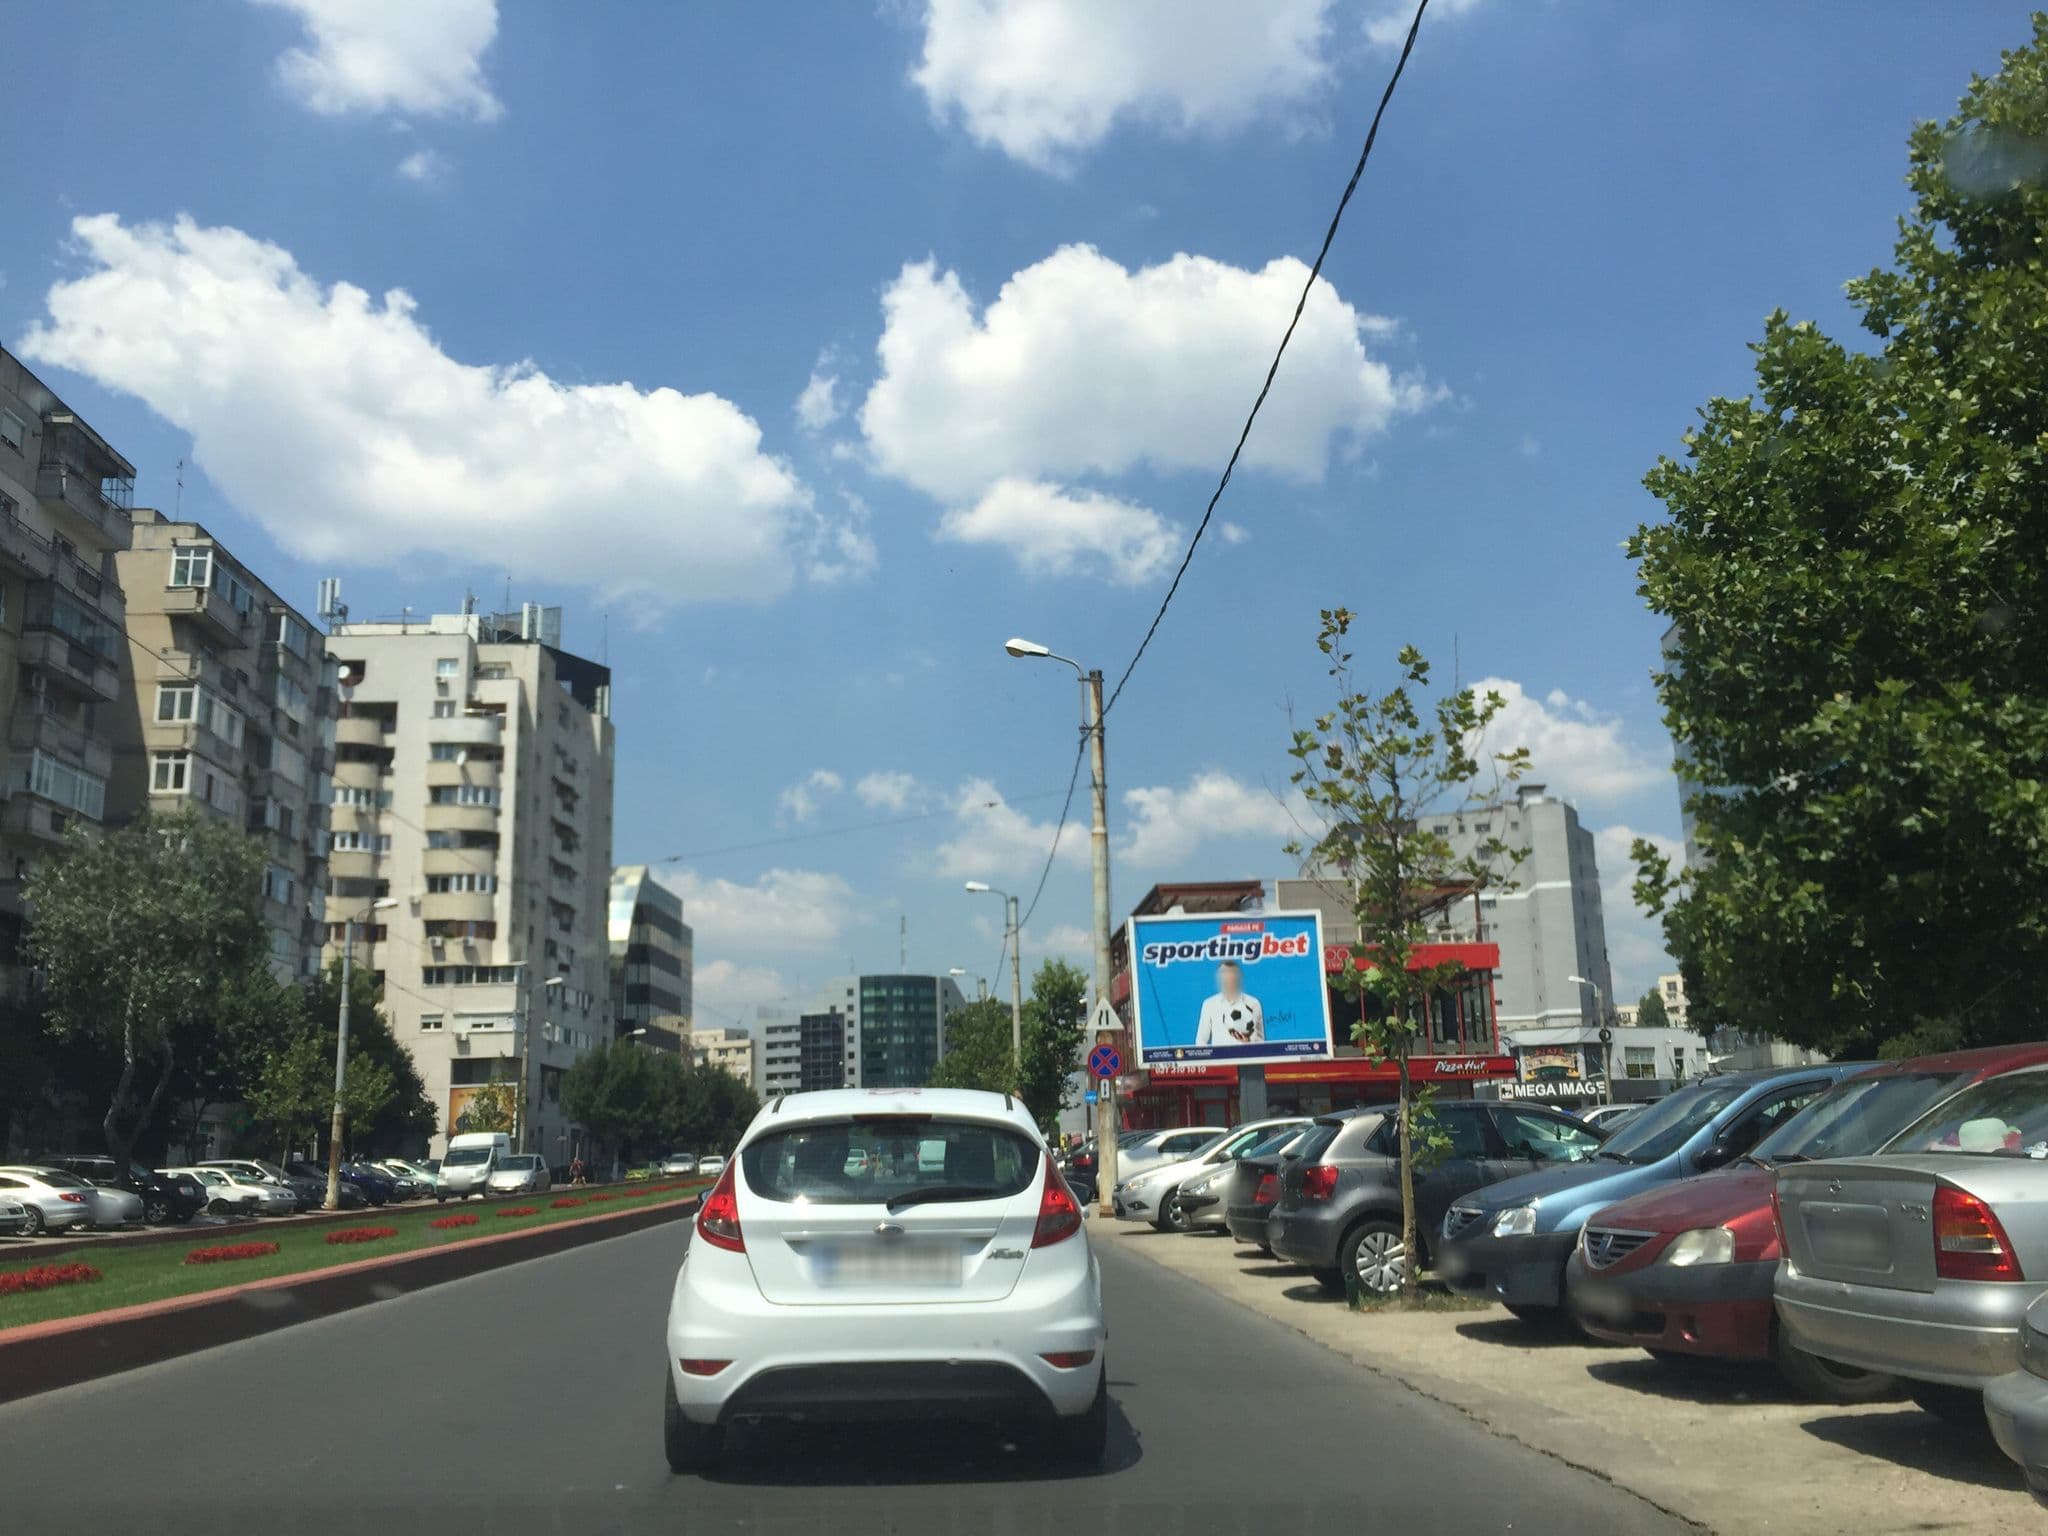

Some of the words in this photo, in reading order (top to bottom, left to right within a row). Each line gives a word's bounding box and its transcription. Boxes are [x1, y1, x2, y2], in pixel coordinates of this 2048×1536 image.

[1144, 933, 1308, 966] sportingbet
[1435, 1060, 1464, 1073] Pizza
[1464, 1059, 1487, 1070] Hut
[1515, 1083, 1557, 1097] MEGA
[1559, 1081, 1606, 1096] IMAGE
